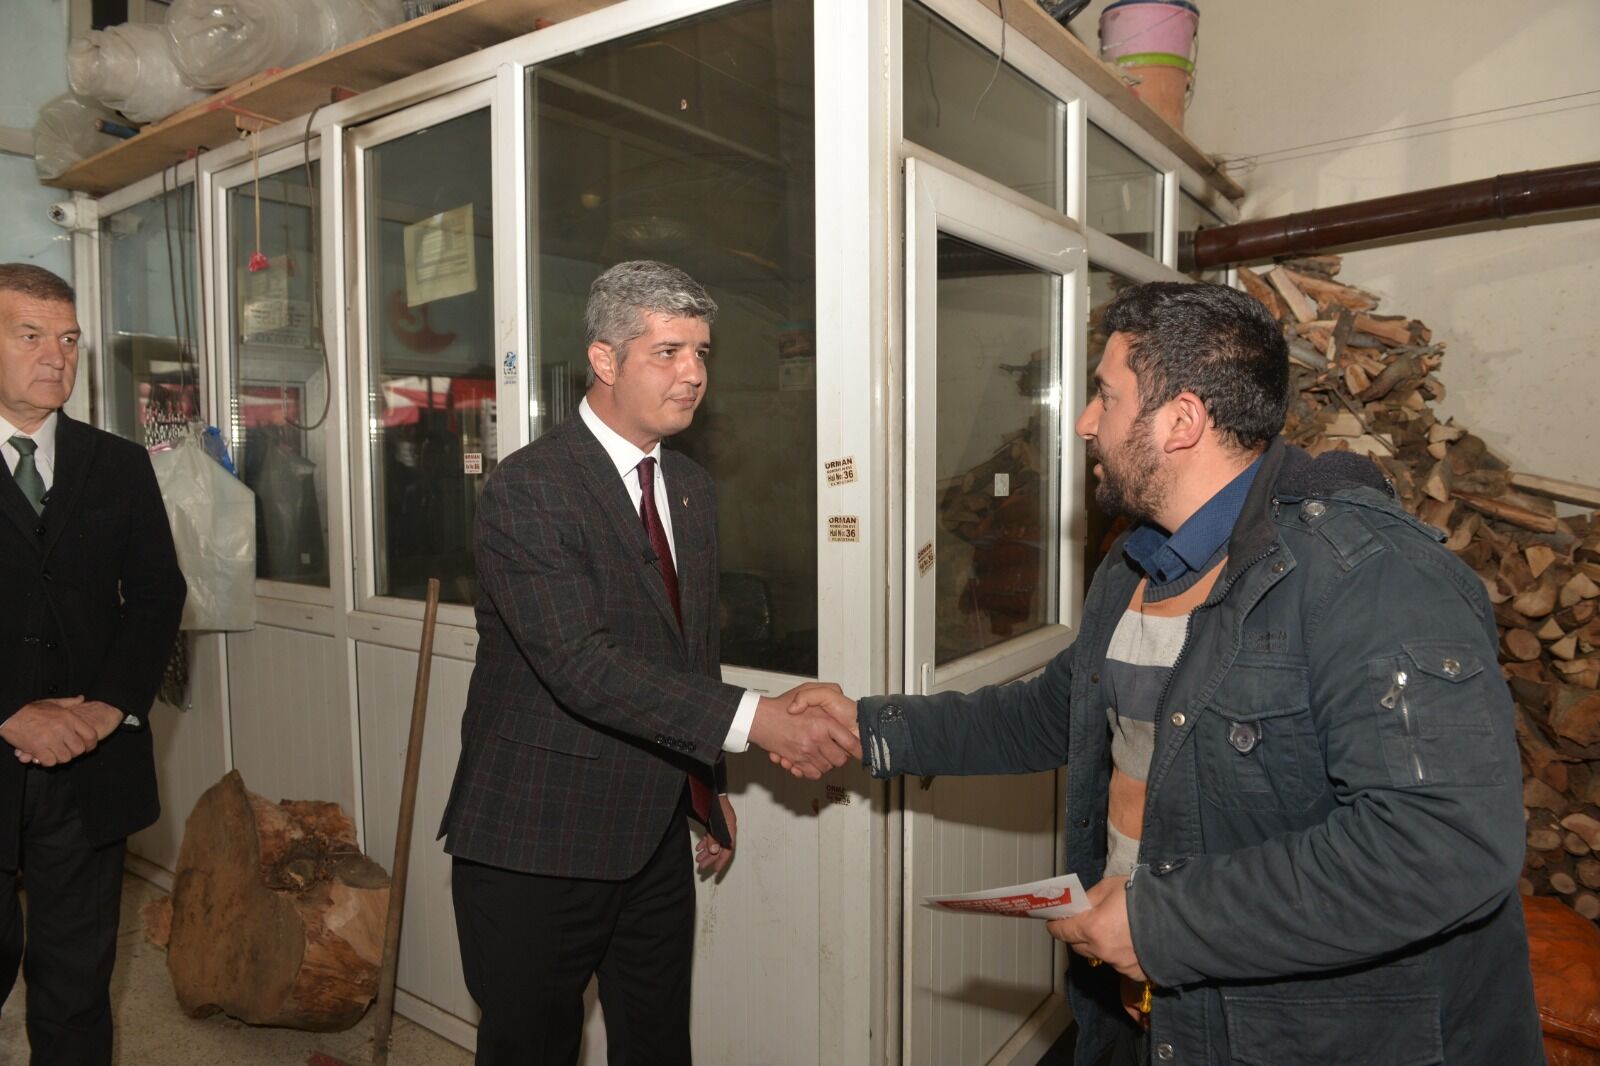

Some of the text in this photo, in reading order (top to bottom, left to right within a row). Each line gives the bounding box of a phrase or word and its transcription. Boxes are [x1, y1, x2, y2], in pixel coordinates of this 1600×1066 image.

[825, 458, 852, 469] ORMAN
[844, 470, 853, 479] 36
[829, 516, 856, 524] ORMAN
[846, 529, 855, 537] 36
